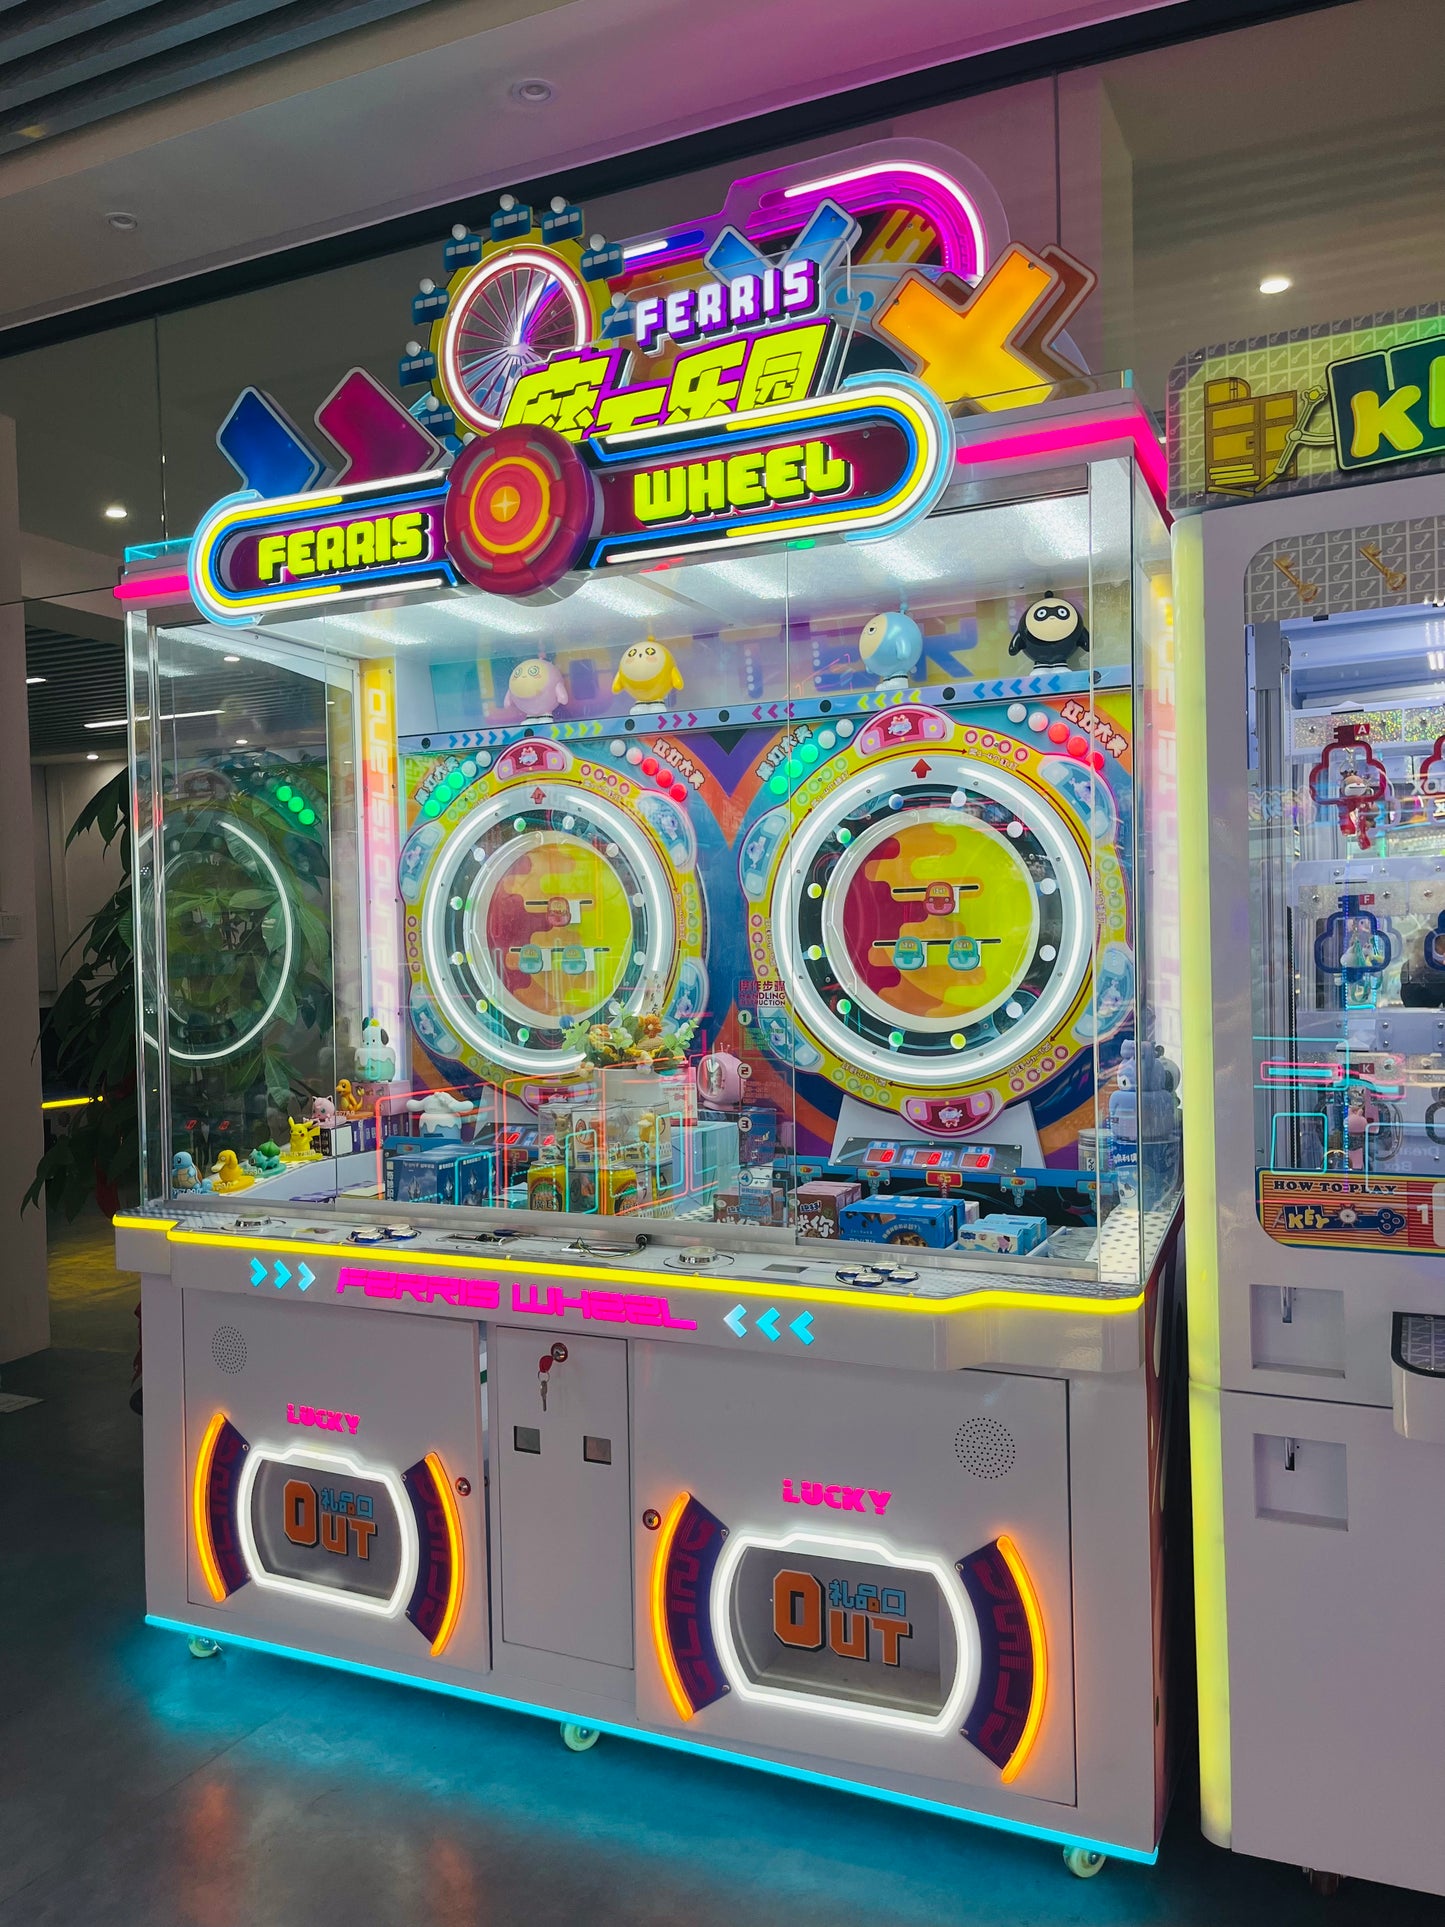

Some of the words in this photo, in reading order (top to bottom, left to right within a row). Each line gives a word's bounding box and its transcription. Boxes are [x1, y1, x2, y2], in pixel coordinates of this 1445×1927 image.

[636, 260, 813, 346] FERRIS
[634, 442, 850, 523] WHEEL
[258, 512, 427, 582] FERRIS
[1357, 725, 1367, 735] A
[1363, 895, 1370, 904] F
[1362, 1064, 1370, 1073] K
[1273, 1180, 1314, 1192] HOW
[1319, 1182, 1344, 1192] TO
[1348, 1183, 1398, 1195] PLAY
[1288, 1208, 1331, 1229] KEY
[1416, 1204, 1430, 1225] 1
[337, 1265, 500, 1310] FERRIS
[511, 1283, 697, 1330] WHEEL
[286, 1403, 361, 1435] LUCKY
[321, 1487, 375, 1519] 礼品口
[781, 1477, 893, 1516] LUCKY
[283, 1479, 377, 1560] OUT
[828, 1579, 907, 1617] 礼品口
[772, 1568, 912, 1667] OUT
